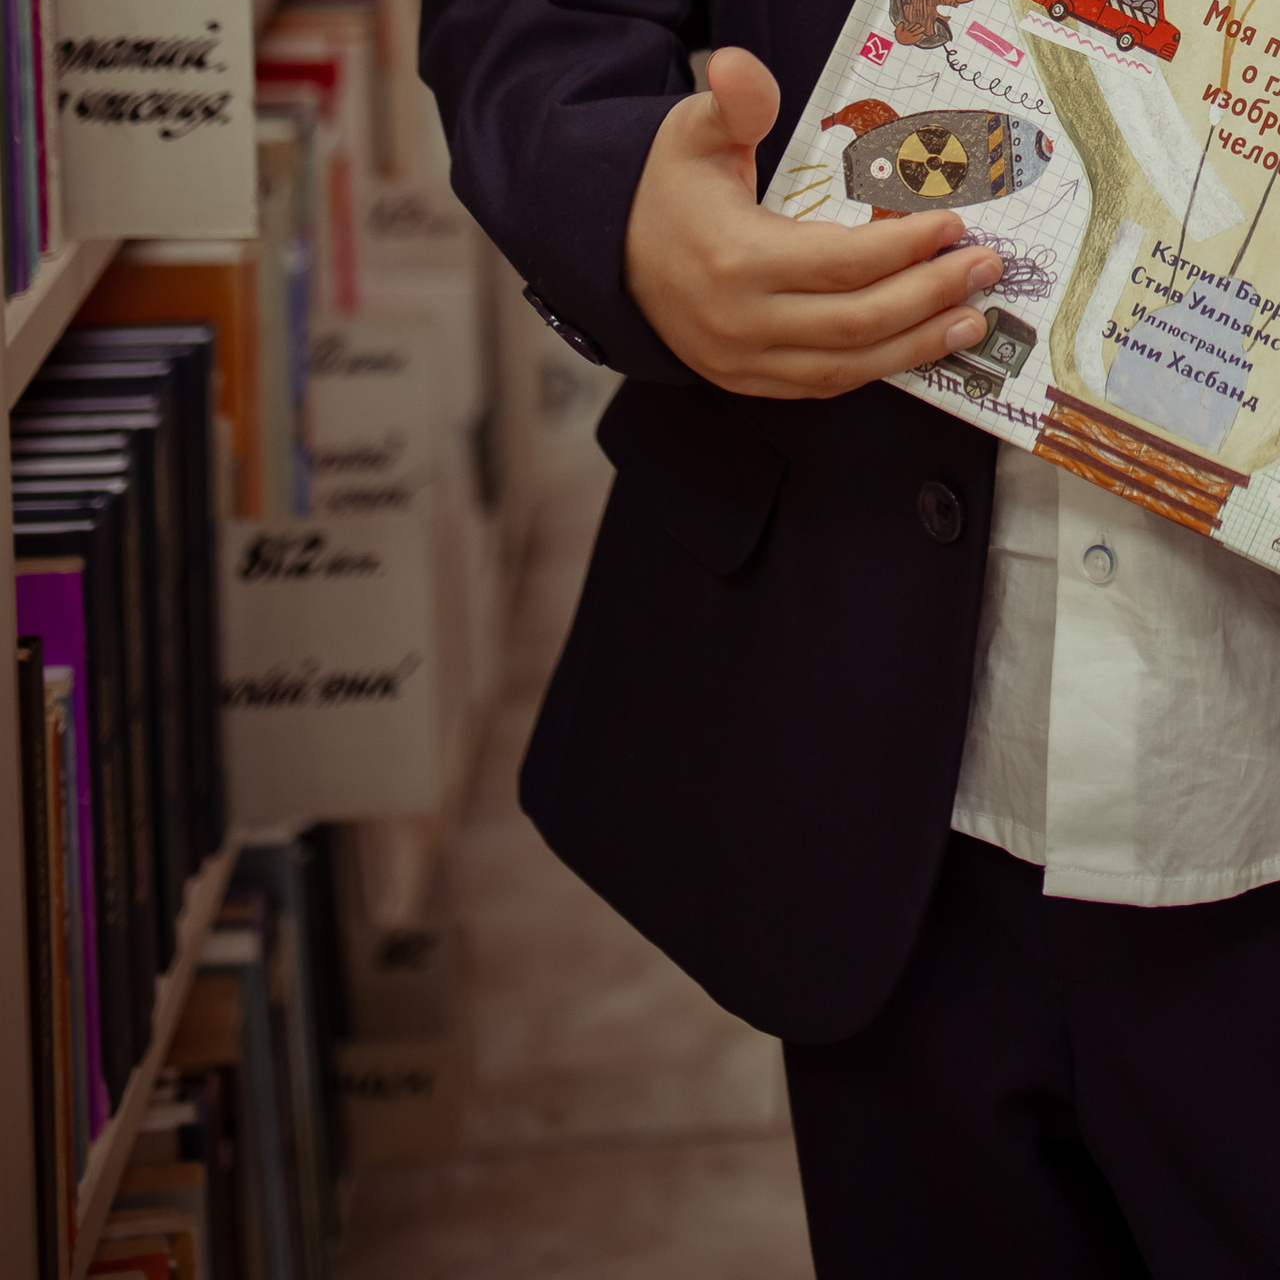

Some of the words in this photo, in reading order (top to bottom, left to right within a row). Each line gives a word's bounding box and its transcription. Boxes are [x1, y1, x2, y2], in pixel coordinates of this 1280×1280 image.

[1203, 0, 1257, 46] Моя
[1241, 65, 1258, 84] о
[1130, 266, 1184, 304] Стив
[1150, 240, 1232, 293] Кэтрин
[1130, 302, 1255, 373] Иллюстрации
[1101, 320, 1163, 364] Эйми
[1166, 350, 1260, 414] Хасбанд
